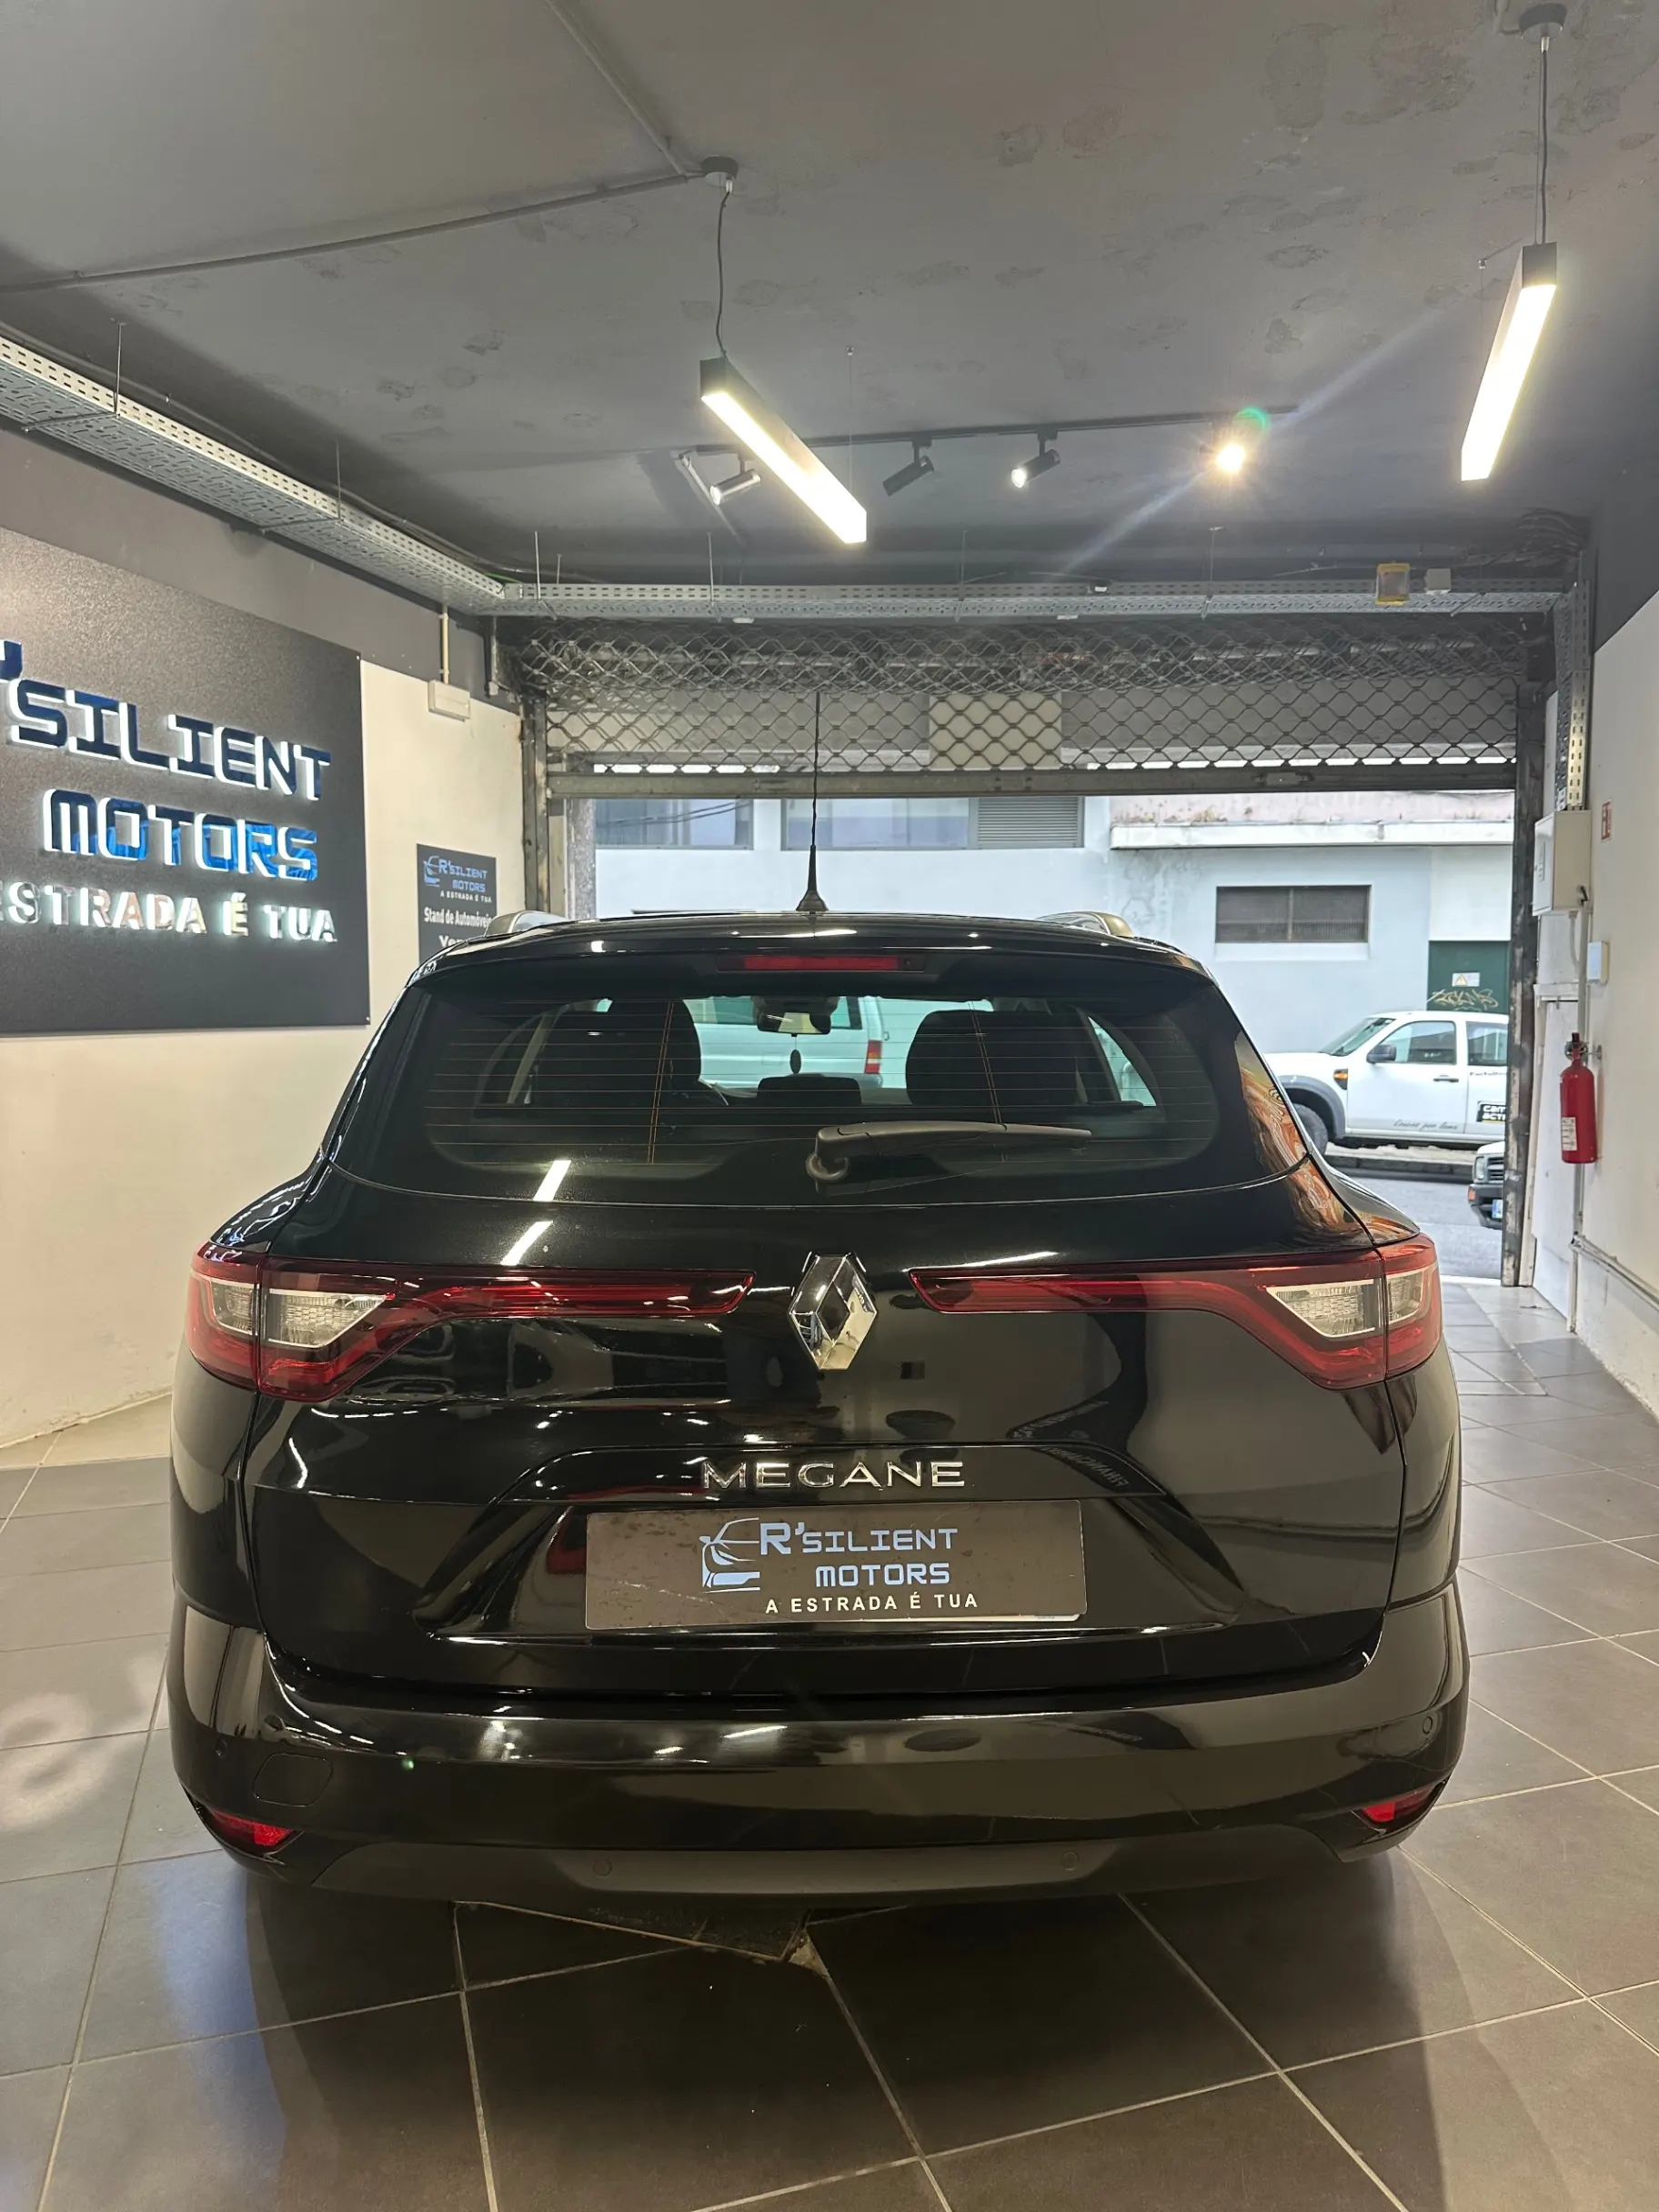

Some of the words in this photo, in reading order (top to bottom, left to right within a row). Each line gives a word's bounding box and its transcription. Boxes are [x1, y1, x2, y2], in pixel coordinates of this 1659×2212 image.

[43, 789, 317, 881] MOTORS
[447, 890, 473, 900] ESTRADA
[480, 895, 492, 903] TUA
[452, 880, 486, 892] MOTORS
[0, 880, 206, 934] STRADA
[223, 892, 248, 936] É
[264, 904, 337, 942] TUA
[424, 907, 445, 923] Stand
[446, 910, 454, 924] de
[703, 1461, 964, 1489] MEGANE
[759, 1522, 958, 1555] R'SILIENT
[816, 1563, 950, 1587] MOTORS
[766, 1598, 778, 1614] A
[790, 1595, 897, 1613] ESTRADA
[910, 1592, 921, 1609] É
[935, 1593, 978, 1608] TUA
